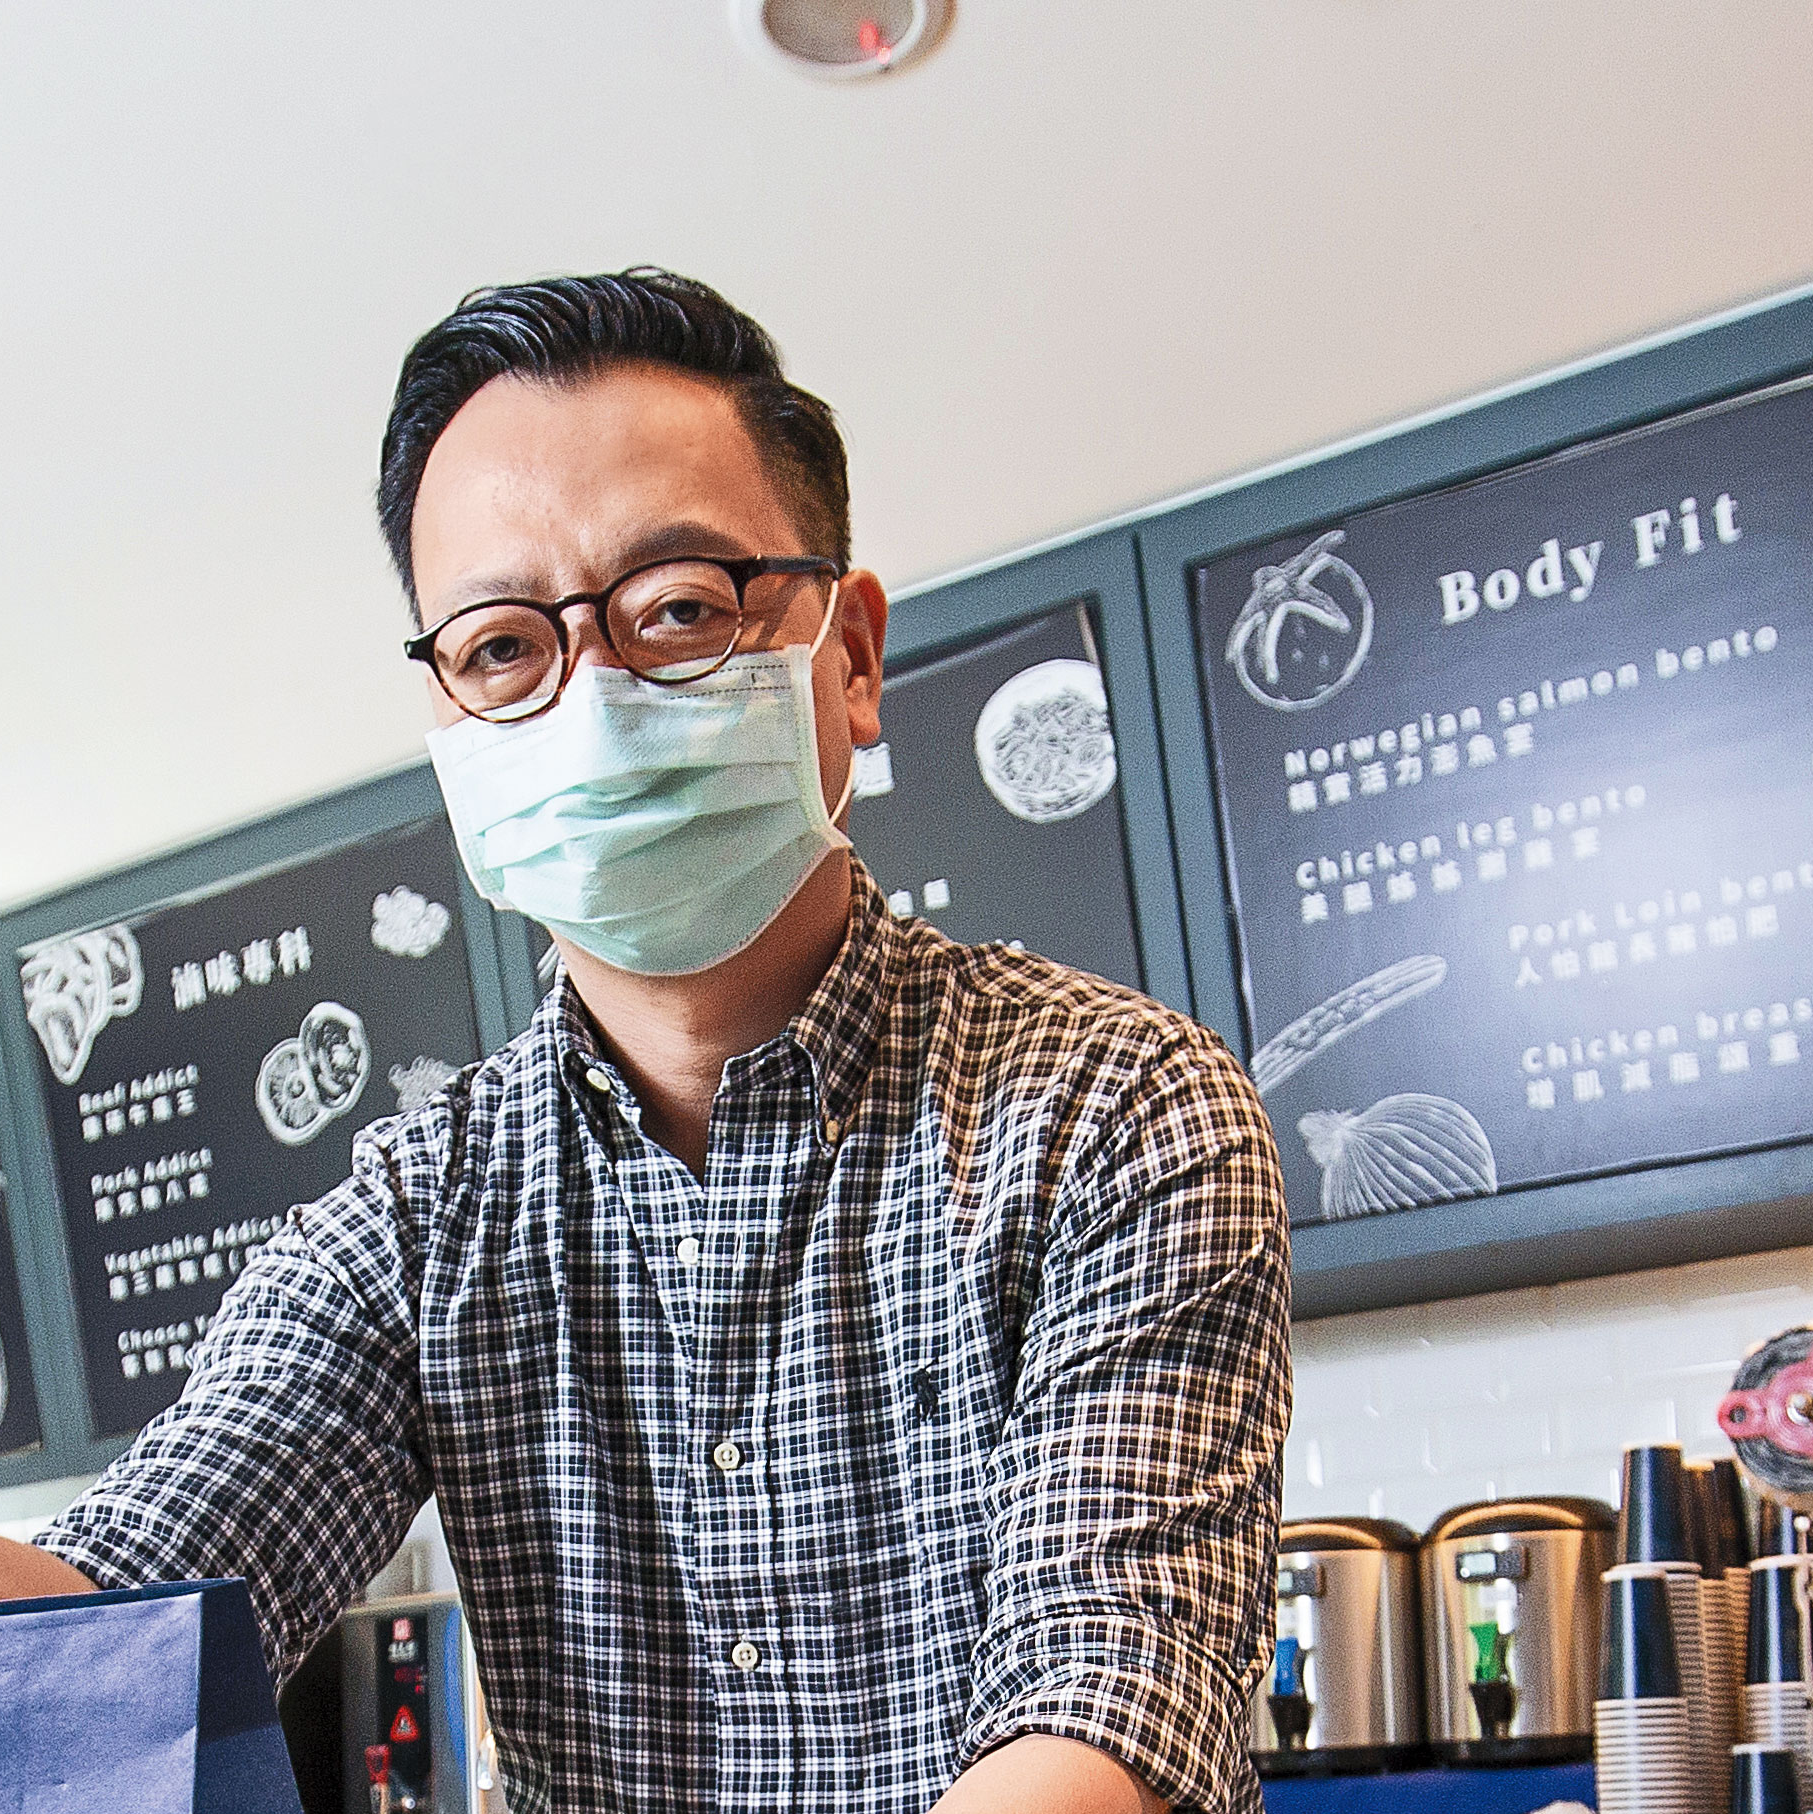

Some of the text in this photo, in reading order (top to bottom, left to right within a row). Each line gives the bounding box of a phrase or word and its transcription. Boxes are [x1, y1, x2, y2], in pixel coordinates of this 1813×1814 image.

[1439, 493, 1742, 626] Body Fit
[1285, 704, 1483, 780] Norwegian
[1496, 661, 1642, 722] salmon
[1654, 625, 1779, 680] bento
[1295, 833, 1442, 892] Chicken
[1455, 814, 1517, 850] leg
[1530, 784, 1648, 832] bento
[1507, 908, 1597, 953] Pork
[1613, 889, 1702, 931] Loin
[1521, 1023, 1679, 1076] Chicken
[90, 1165, 139, 1197] Pork
[104, 1233, 210, 1275] Vegetable
[117, 1320, 193, 1354] Choose
